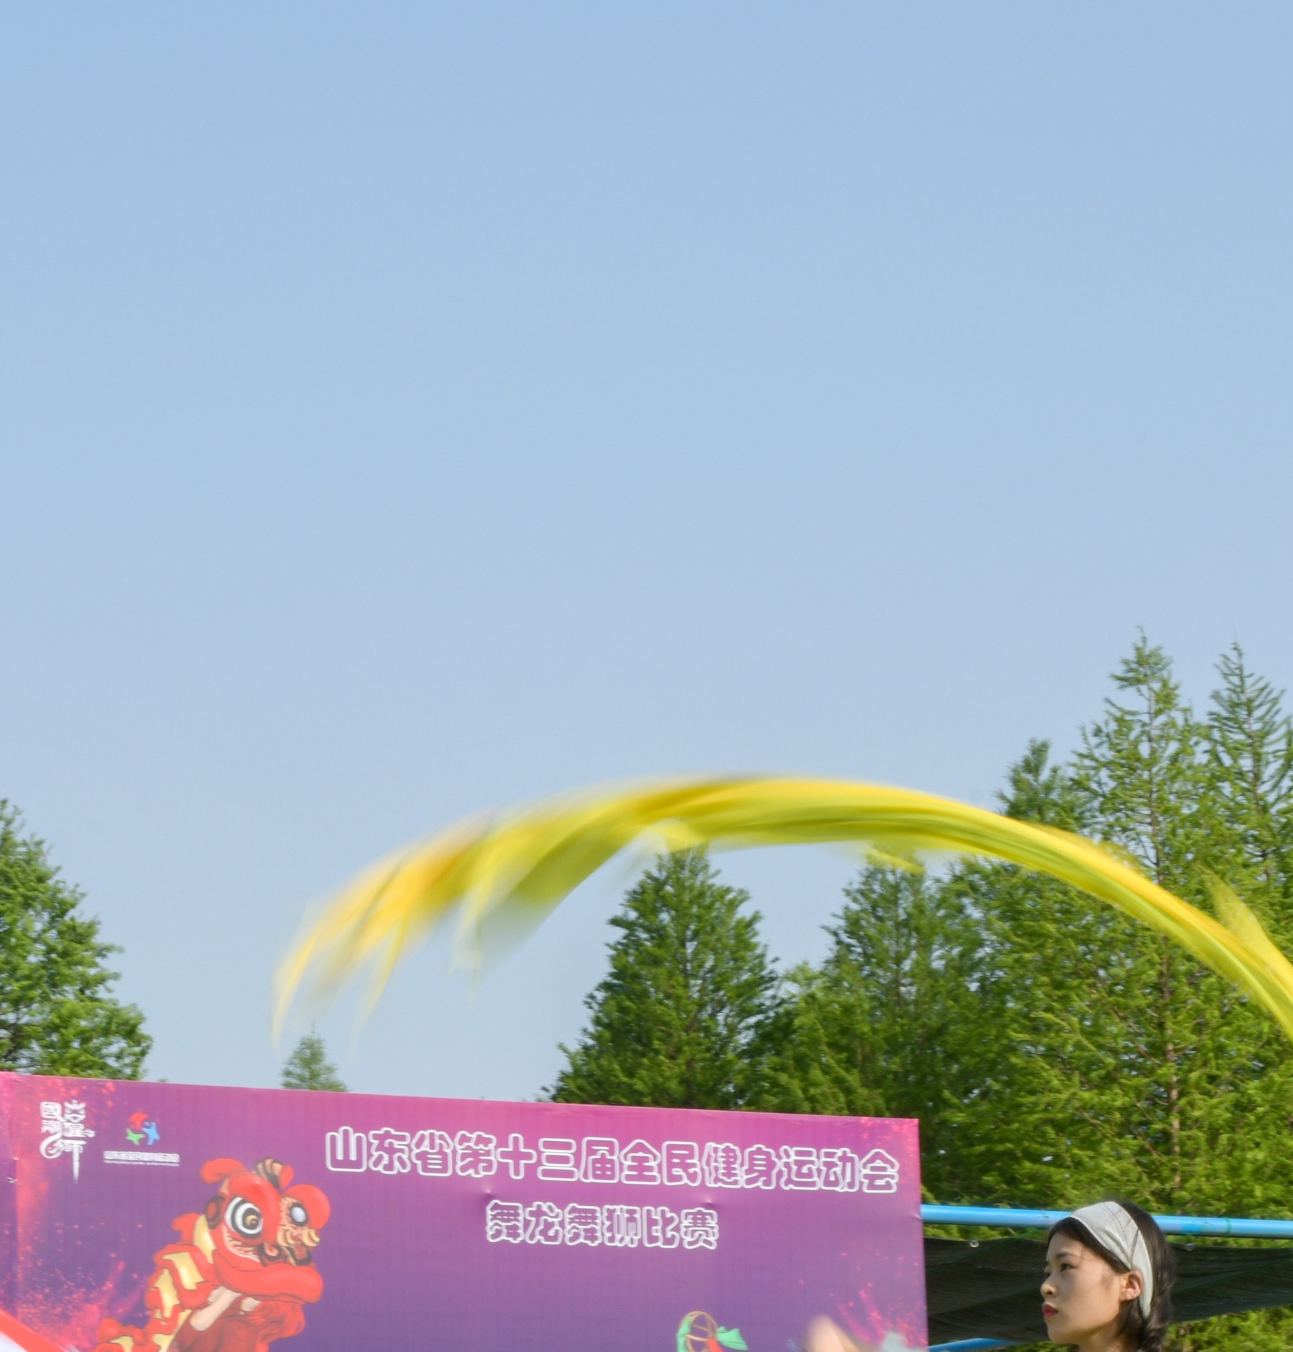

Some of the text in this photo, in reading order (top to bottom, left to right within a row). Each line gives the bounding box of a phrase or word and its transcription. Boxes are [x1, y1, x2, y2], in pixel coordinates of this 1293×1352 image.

[325, 1126, 900, 1193] 山东省第十三届全民健身运动会
[485, 1201, 720, 1250] 舞龙舞狮比赛
